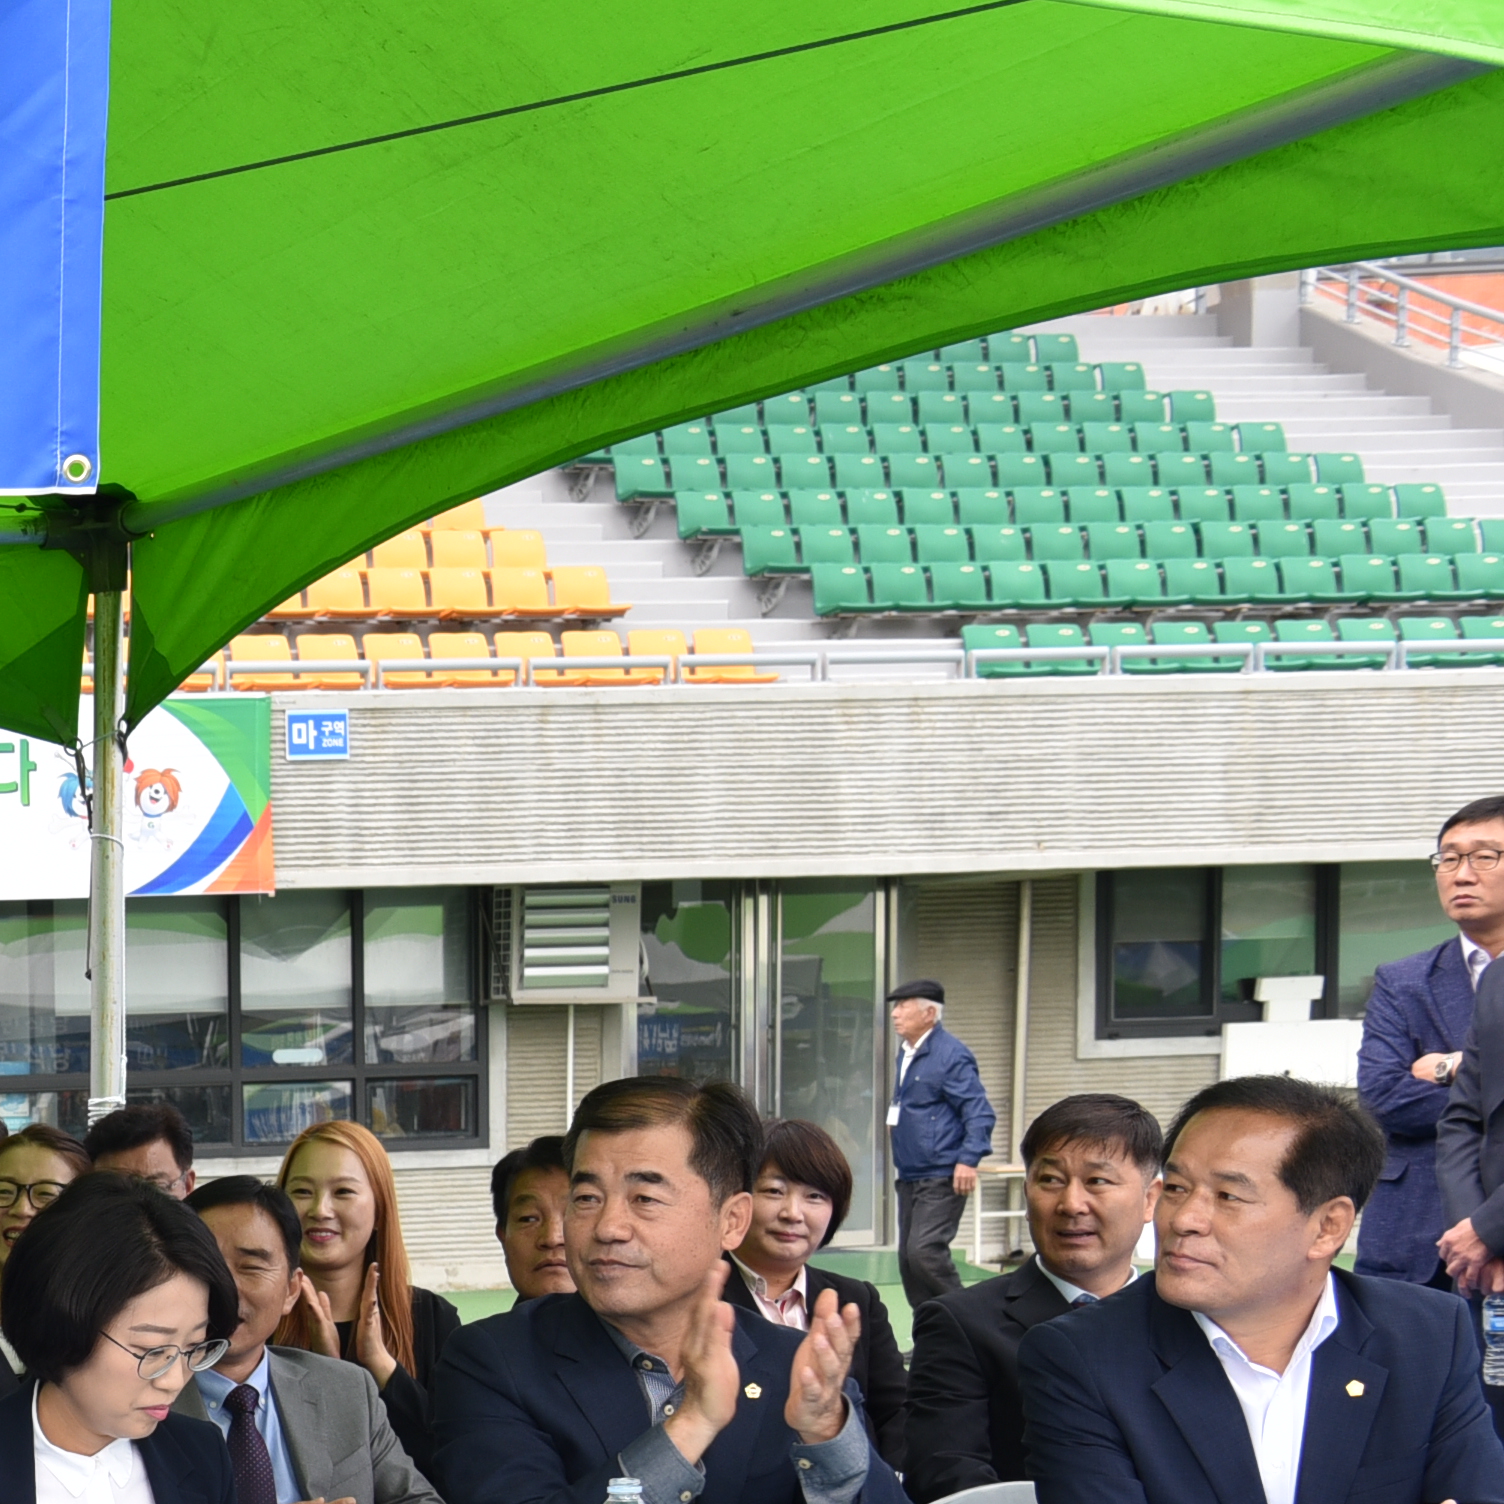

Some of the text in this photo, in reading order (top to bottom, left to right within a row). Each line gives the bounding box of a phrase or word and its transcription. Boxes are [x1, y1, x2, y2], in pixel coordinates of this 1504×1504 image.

[292, 719, 345, 750] 마 구역
[321, 737, 345, 748] ZONE
